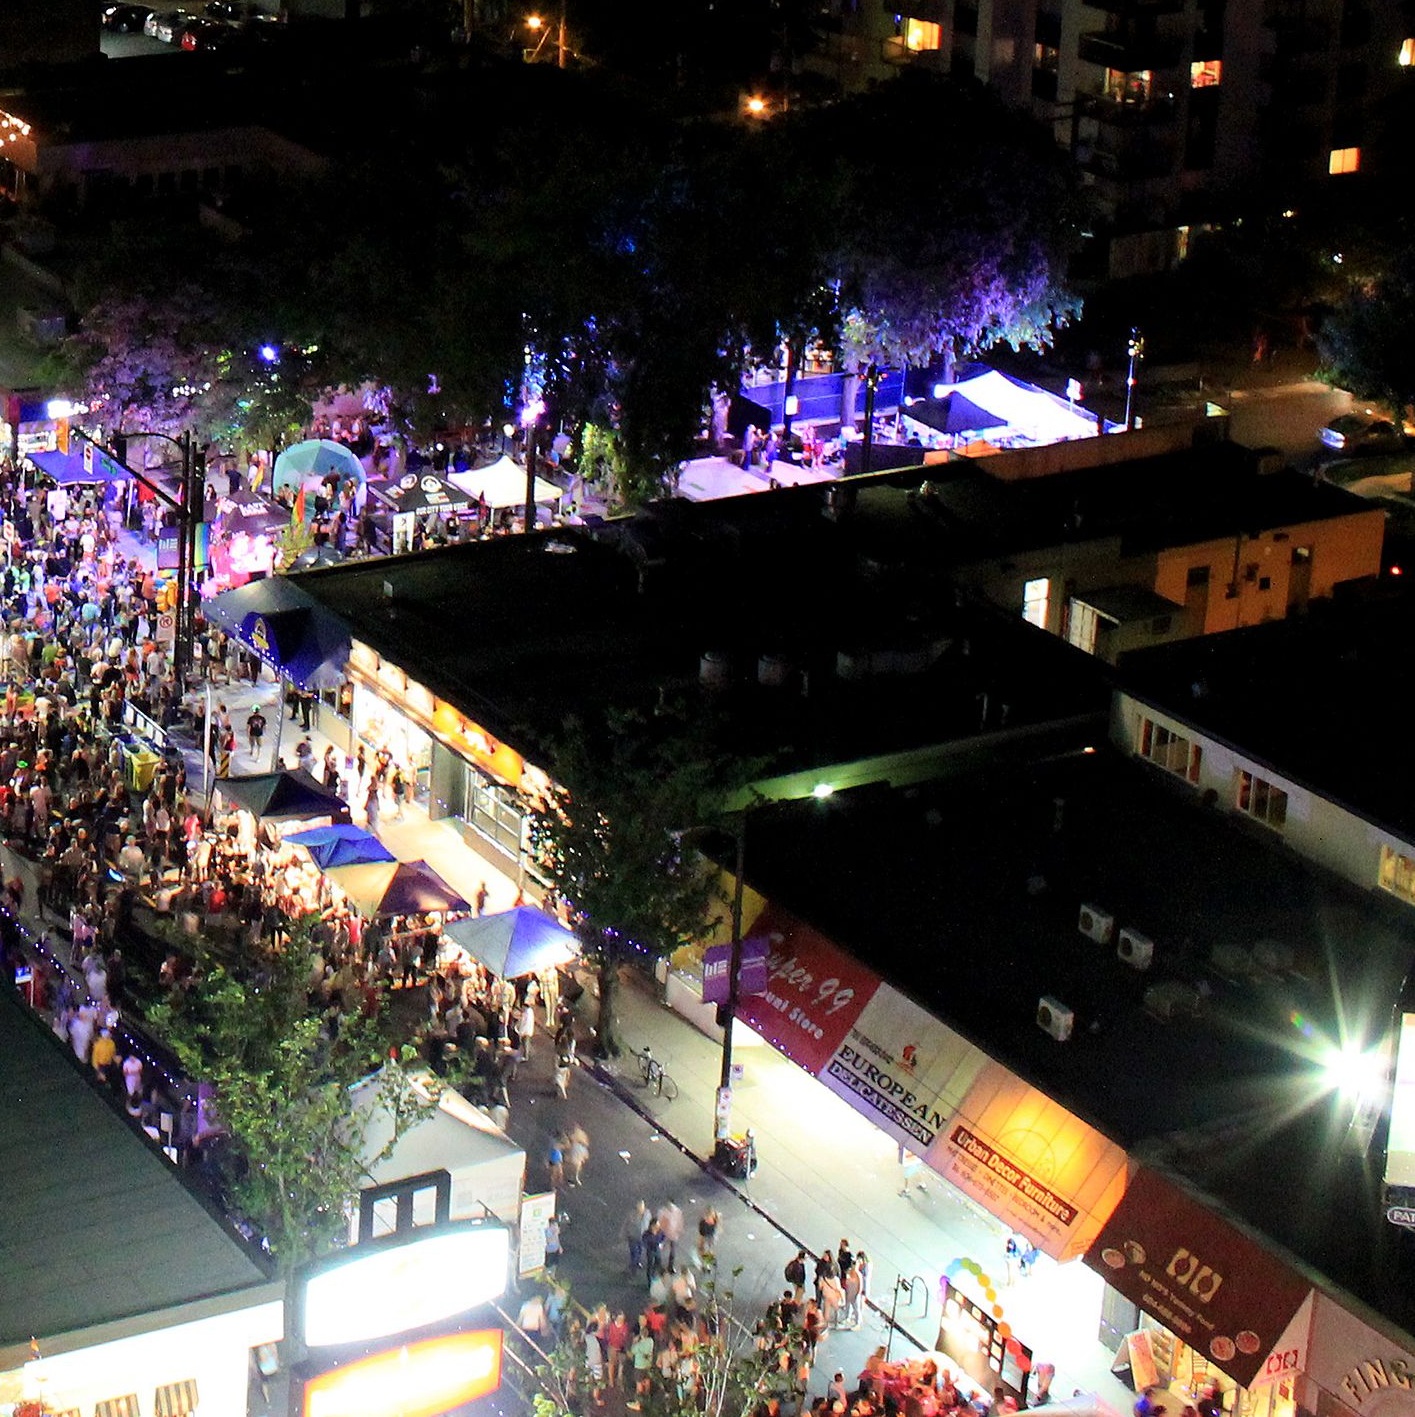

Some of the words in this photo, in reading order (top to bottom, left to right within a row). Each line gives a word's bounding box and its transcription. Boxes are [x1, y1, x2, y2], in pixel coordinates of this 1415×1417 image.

[788, 1006, 824, 1040] Store
[811, 977, 855, 1016] 99
[830, 1062, 932, 1143] DELICATESSEN
[838, 1044, 946, 1130] EUROPEAN
[956, 1130, 990, 1163] Urban
[987, 1153, 1022, 1185] Decor
[1018, 1177, 1071, 1222] Furniture
